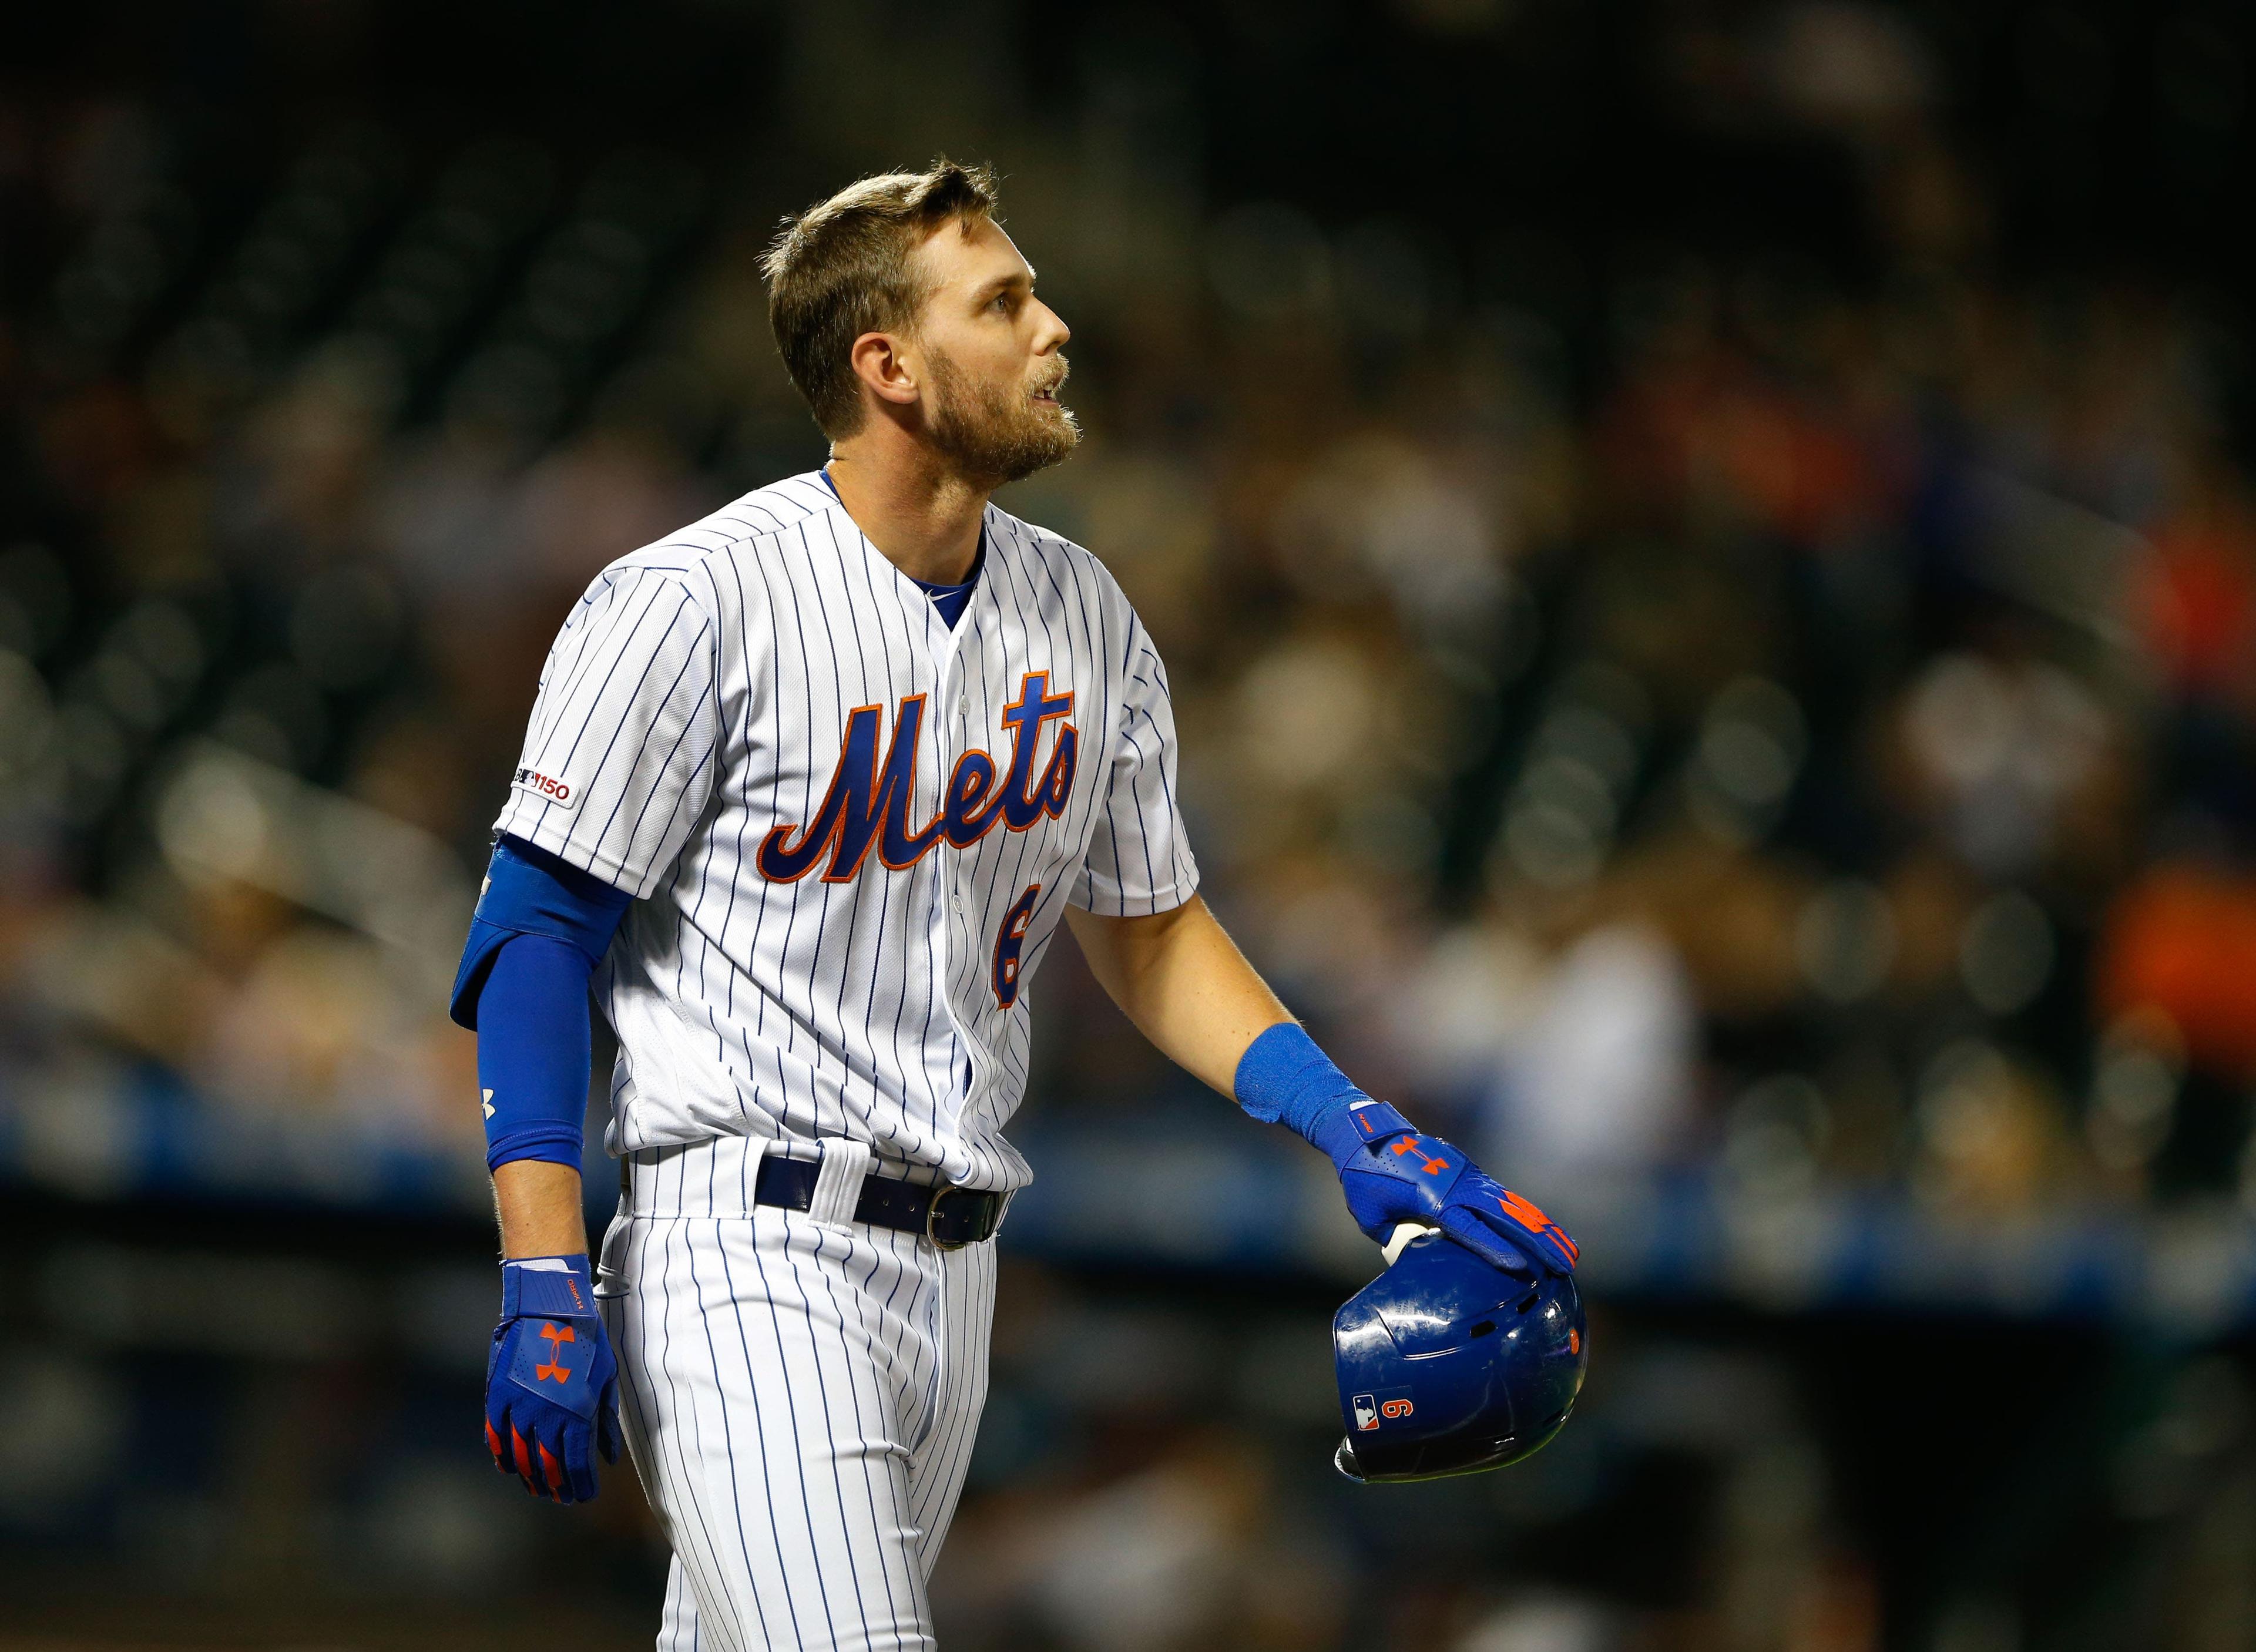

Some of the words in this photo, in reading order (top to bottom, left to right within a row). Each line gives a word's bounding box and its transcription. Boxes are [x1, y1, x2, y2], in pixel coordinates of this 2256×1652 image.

[539, 775, 569, 800] 150
[756, 670, 1079, 883] Mets
[992, 883, 1041, 1011] 6
[1381, 1399, 1414, 1419] 6
